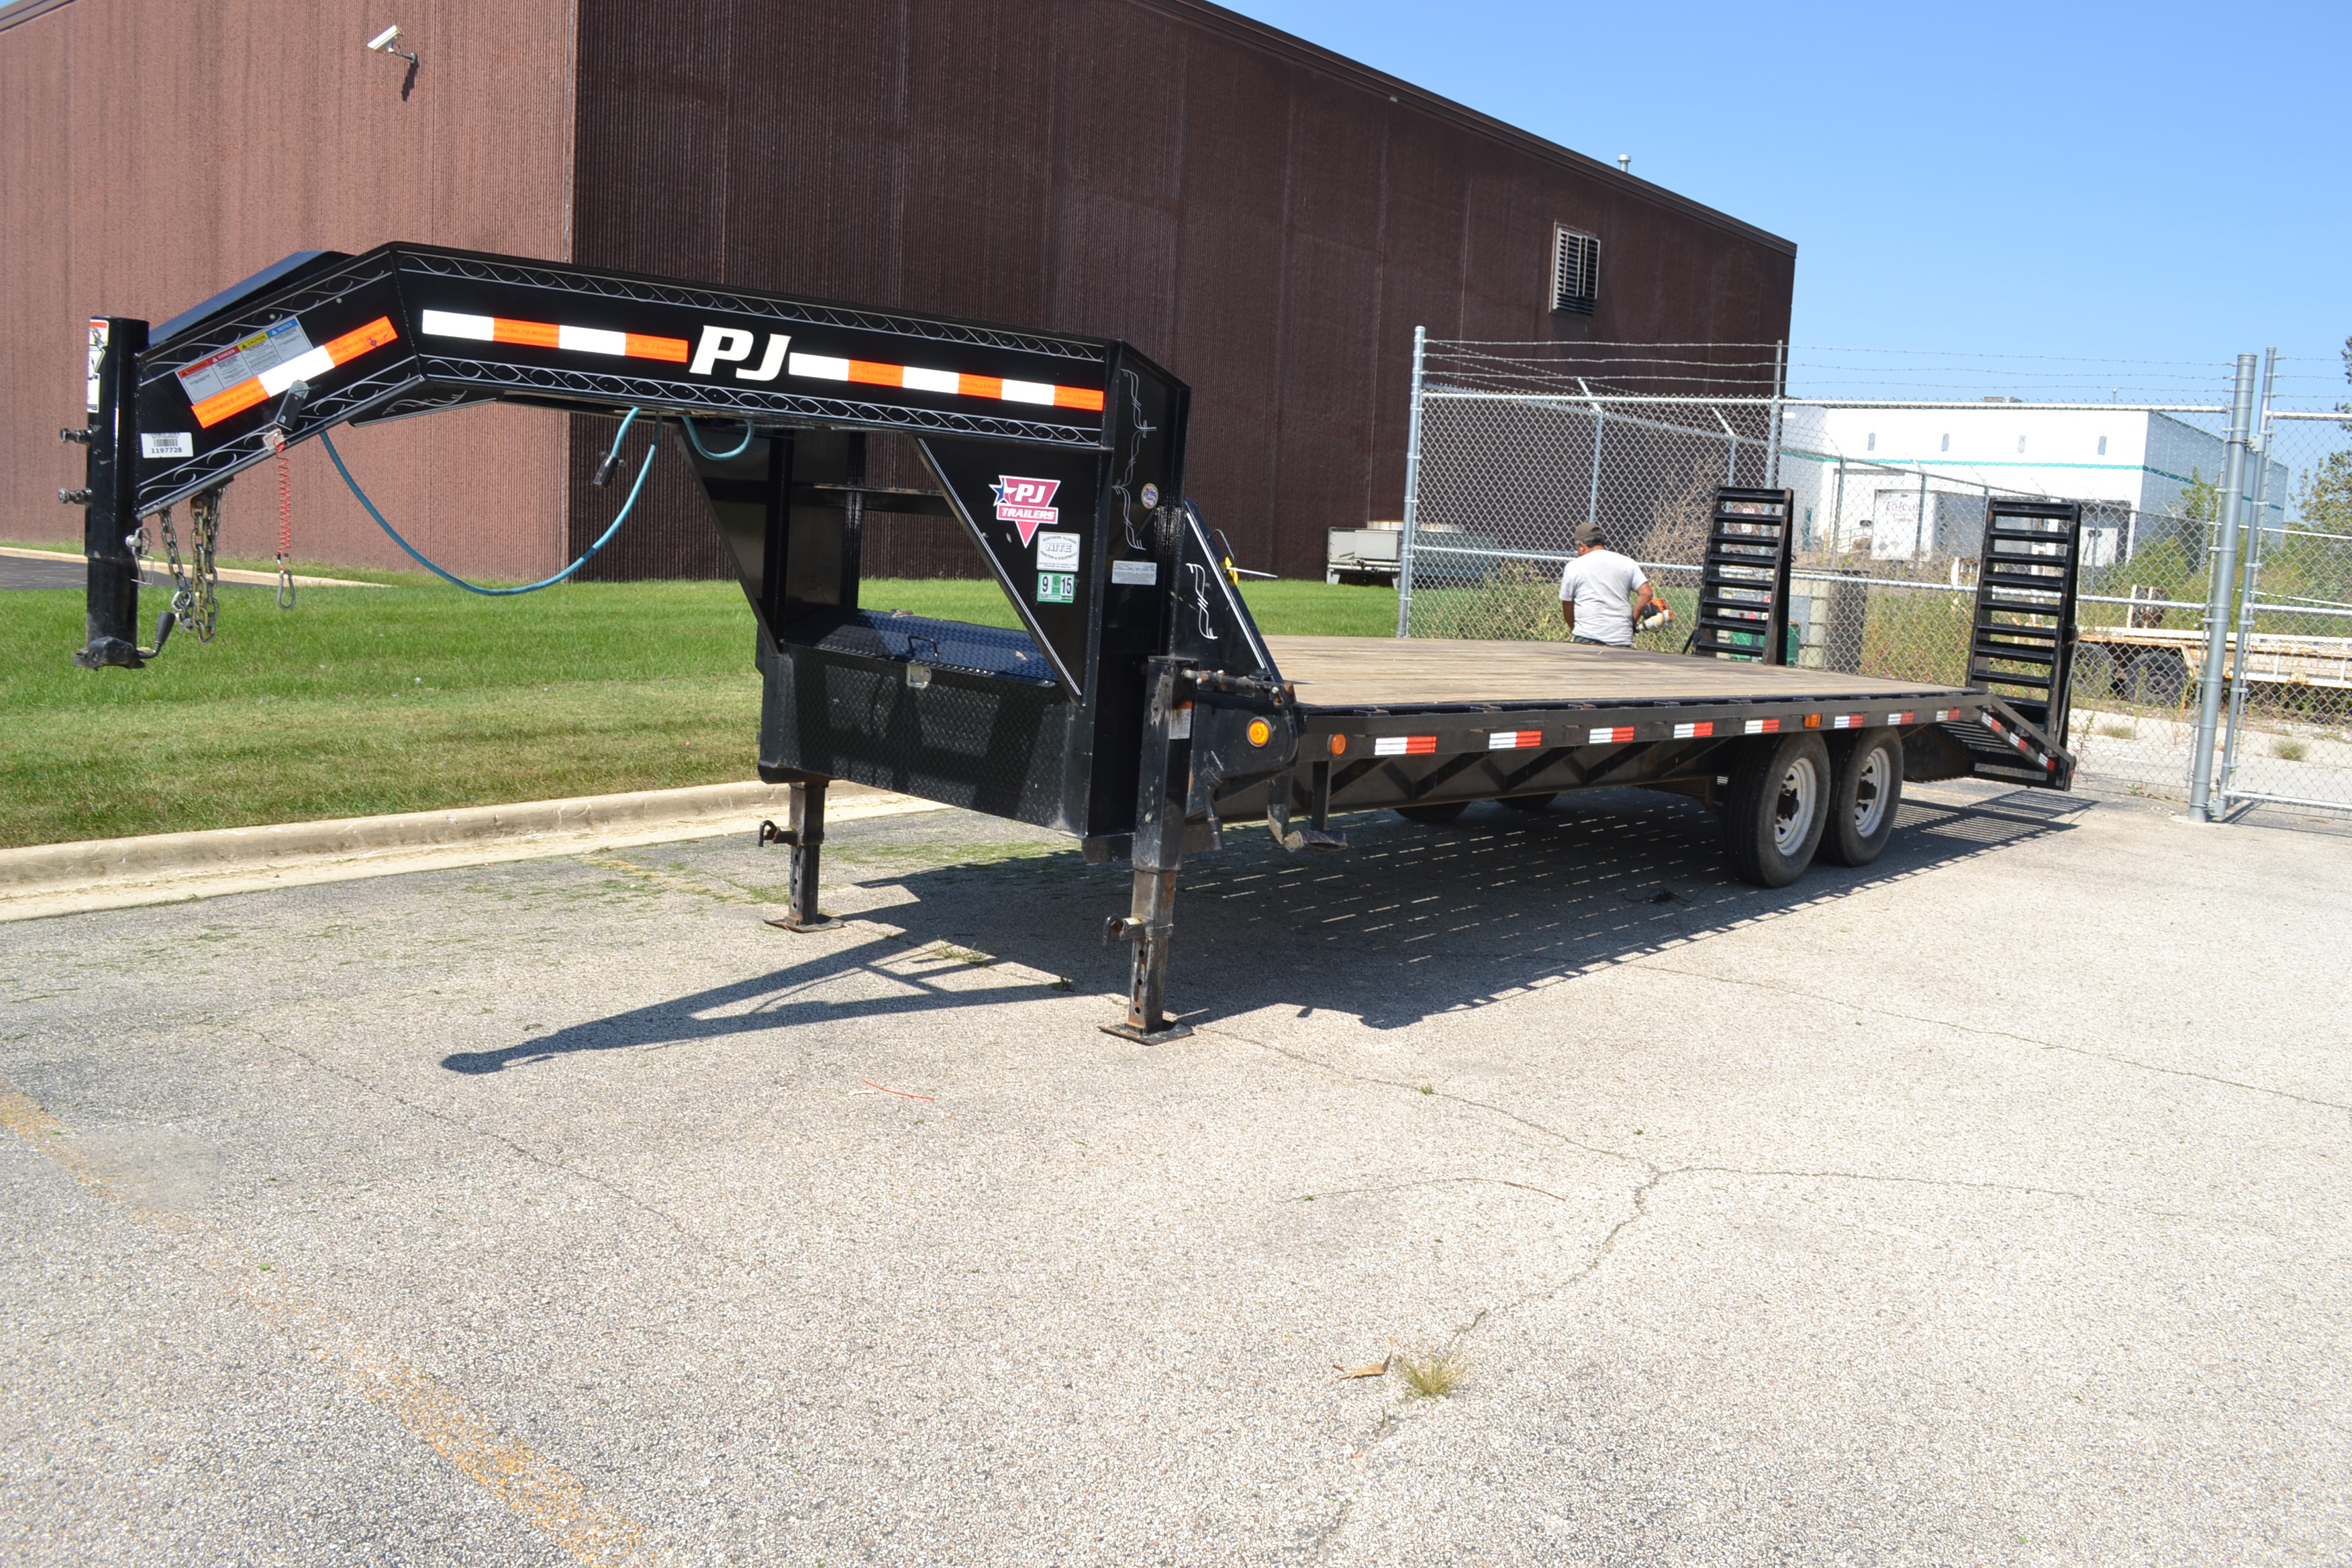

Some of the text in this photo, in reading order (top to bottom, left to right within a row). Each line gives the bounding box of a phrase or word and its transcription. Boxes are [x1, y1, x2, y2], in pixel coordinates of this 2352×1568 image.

[277, 322, 293, 331] NOTICE
[247, 335, 266, 346] CAUTION
[217, 349, 236, 360] DANGER
[689, 325, 791, 381] PJ
[1014, 483, 1046, 503] PJ
[1002, 508, 1055, 520] TRAILERS
[1046, 542, 1072, 553] NITE
[1042, 576, 1072, 594] 9 15
